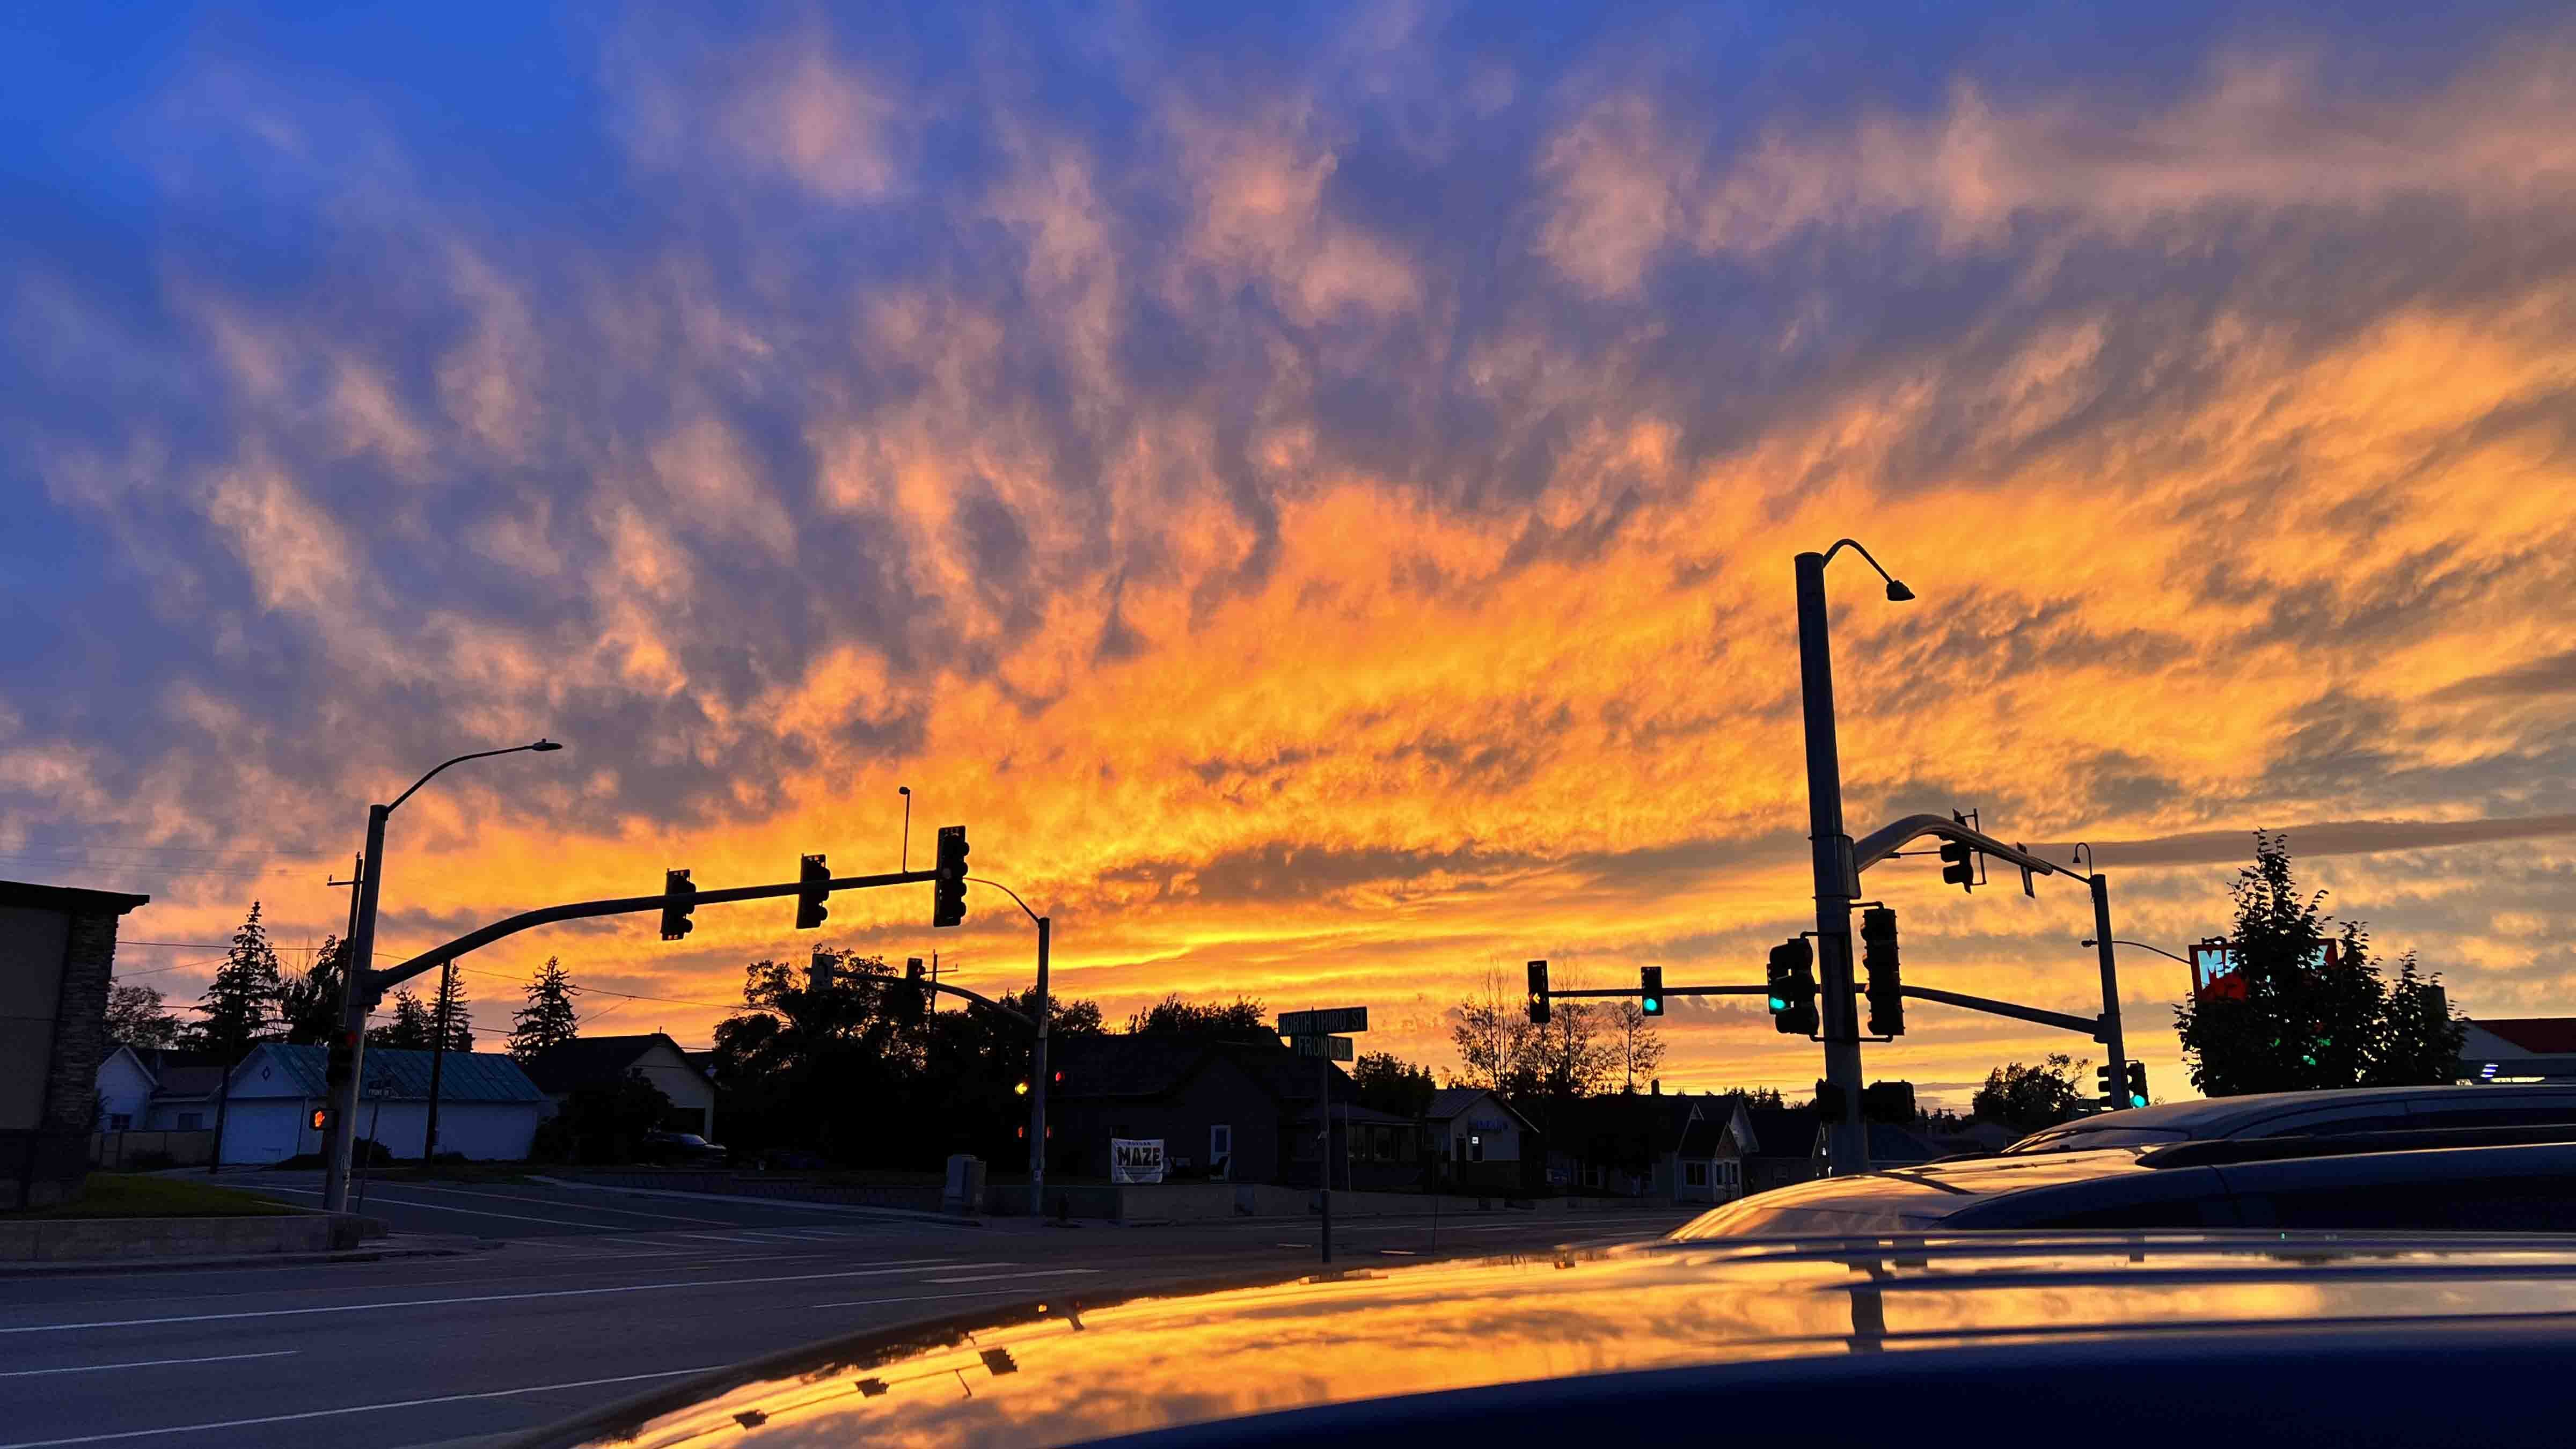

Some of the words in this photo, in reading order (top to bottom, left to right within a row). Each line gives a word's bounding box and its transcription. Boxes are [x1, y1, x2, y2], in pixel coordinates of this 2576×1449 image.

[1280, 1013, 1312, 1035] NORTH
[1315, 1011, 1346, 1031] THIRD
[1298, 1036, 1331, 1058] FRONT
[1117, 1147, 1160, 1166] MAZE
